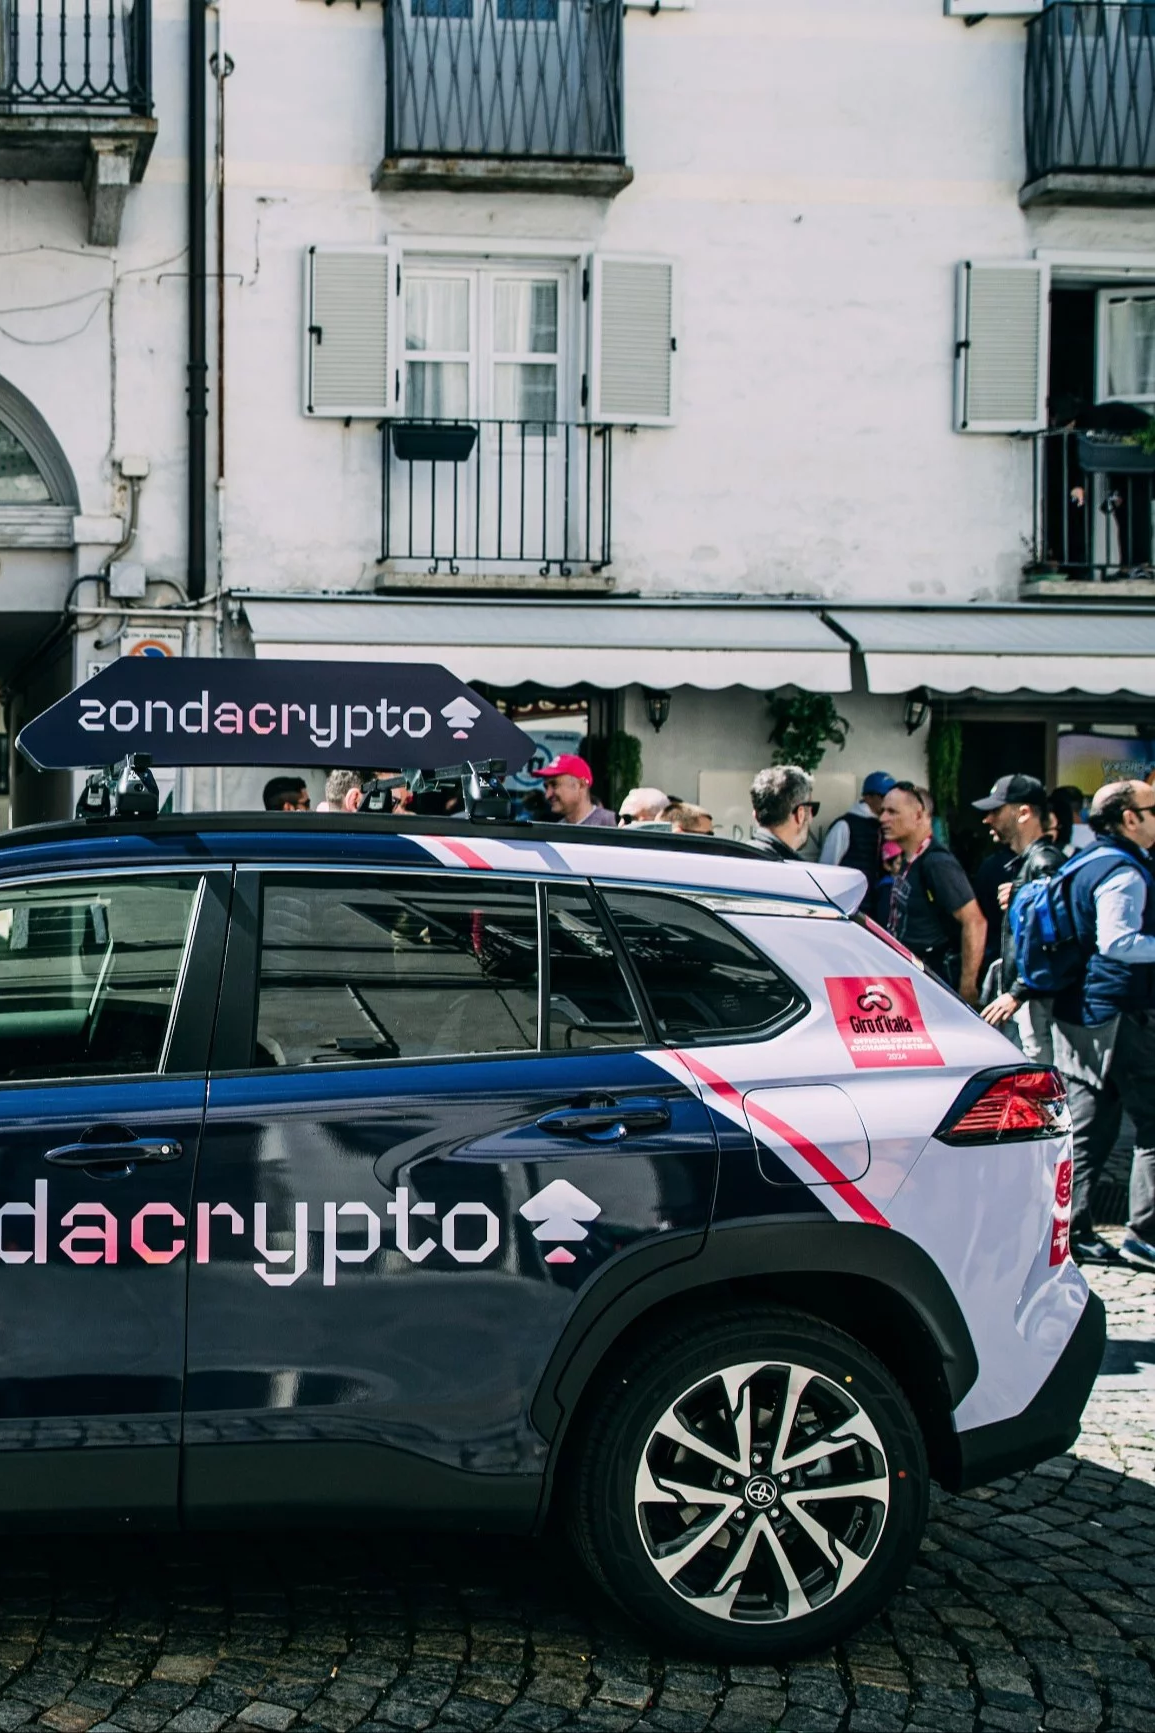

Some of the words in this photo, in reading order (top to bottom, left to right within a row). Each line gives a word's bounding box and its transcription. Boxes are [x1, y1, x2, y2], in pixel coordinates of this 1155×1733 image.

[77, 690, 432, 749] zondacrypto
[849, 1015, 876, 1034] Giro
[853, 1036, 891, 1045] OFFICIAL
[891, 1036, 924, 1044] CRYPTO
[850, 1044, 896, 1052] EXCHANGE
[897, 1043, 934, 1051] PARTNER
[886, 1052, 908, 1060] 2024
